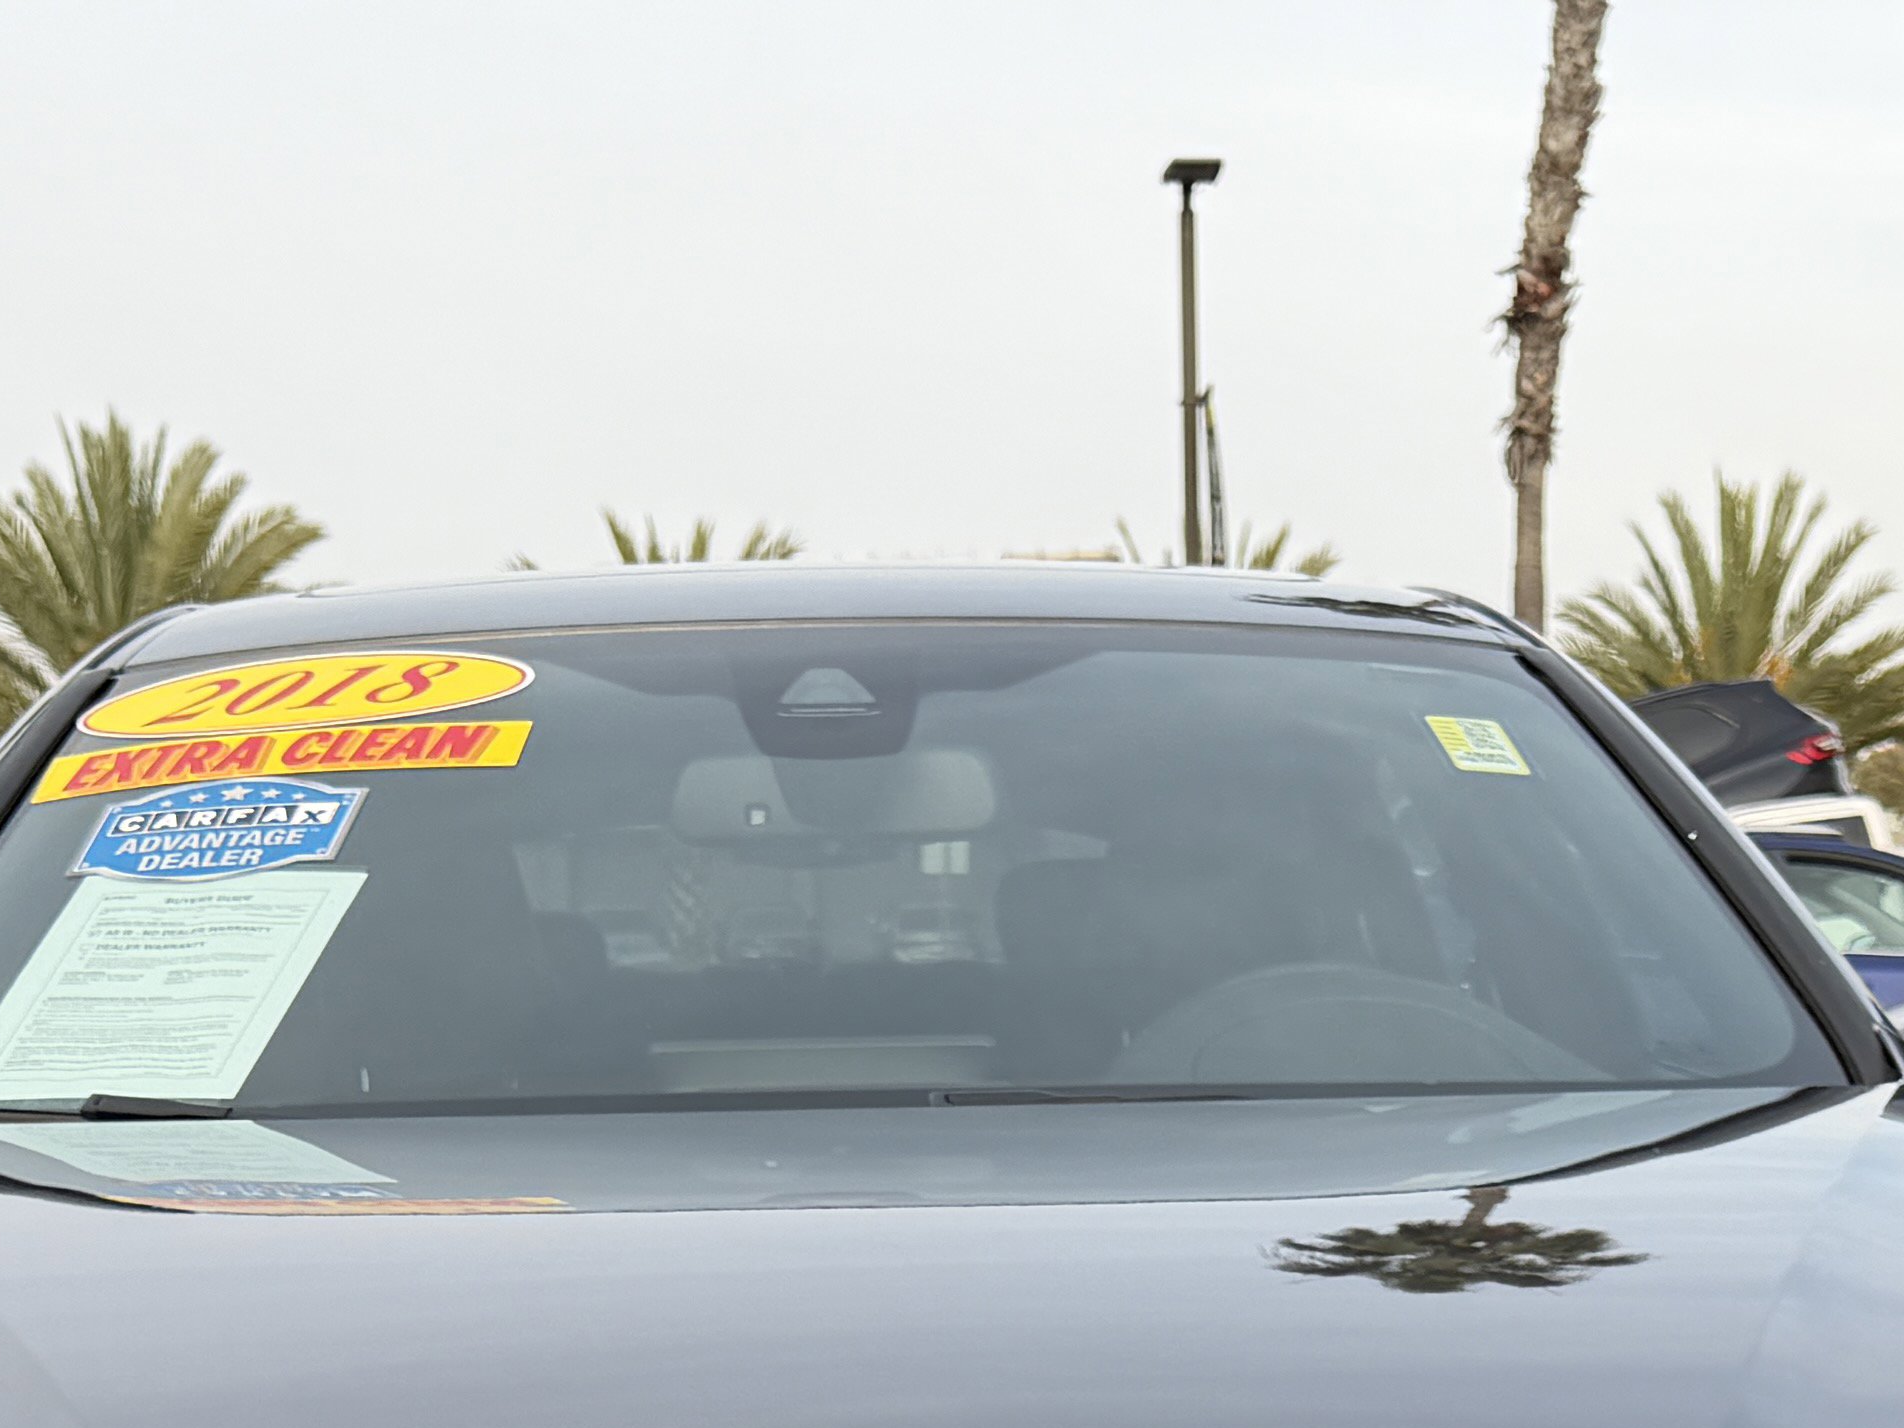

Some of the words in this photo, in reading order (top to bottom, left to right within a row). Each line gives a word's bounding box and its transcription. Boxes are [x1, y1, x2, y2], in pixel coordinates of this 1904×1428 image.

[140, 660, 461, 727] 2018
[63, 735, 276, 791] EXTRA
[280, 725, 496, 768] CLEAN
[117, 804, 328, 832] CARFAX
[114, 828, 308, 856] ADVANTAGE
[137, 849, 264, 872] DEALER
